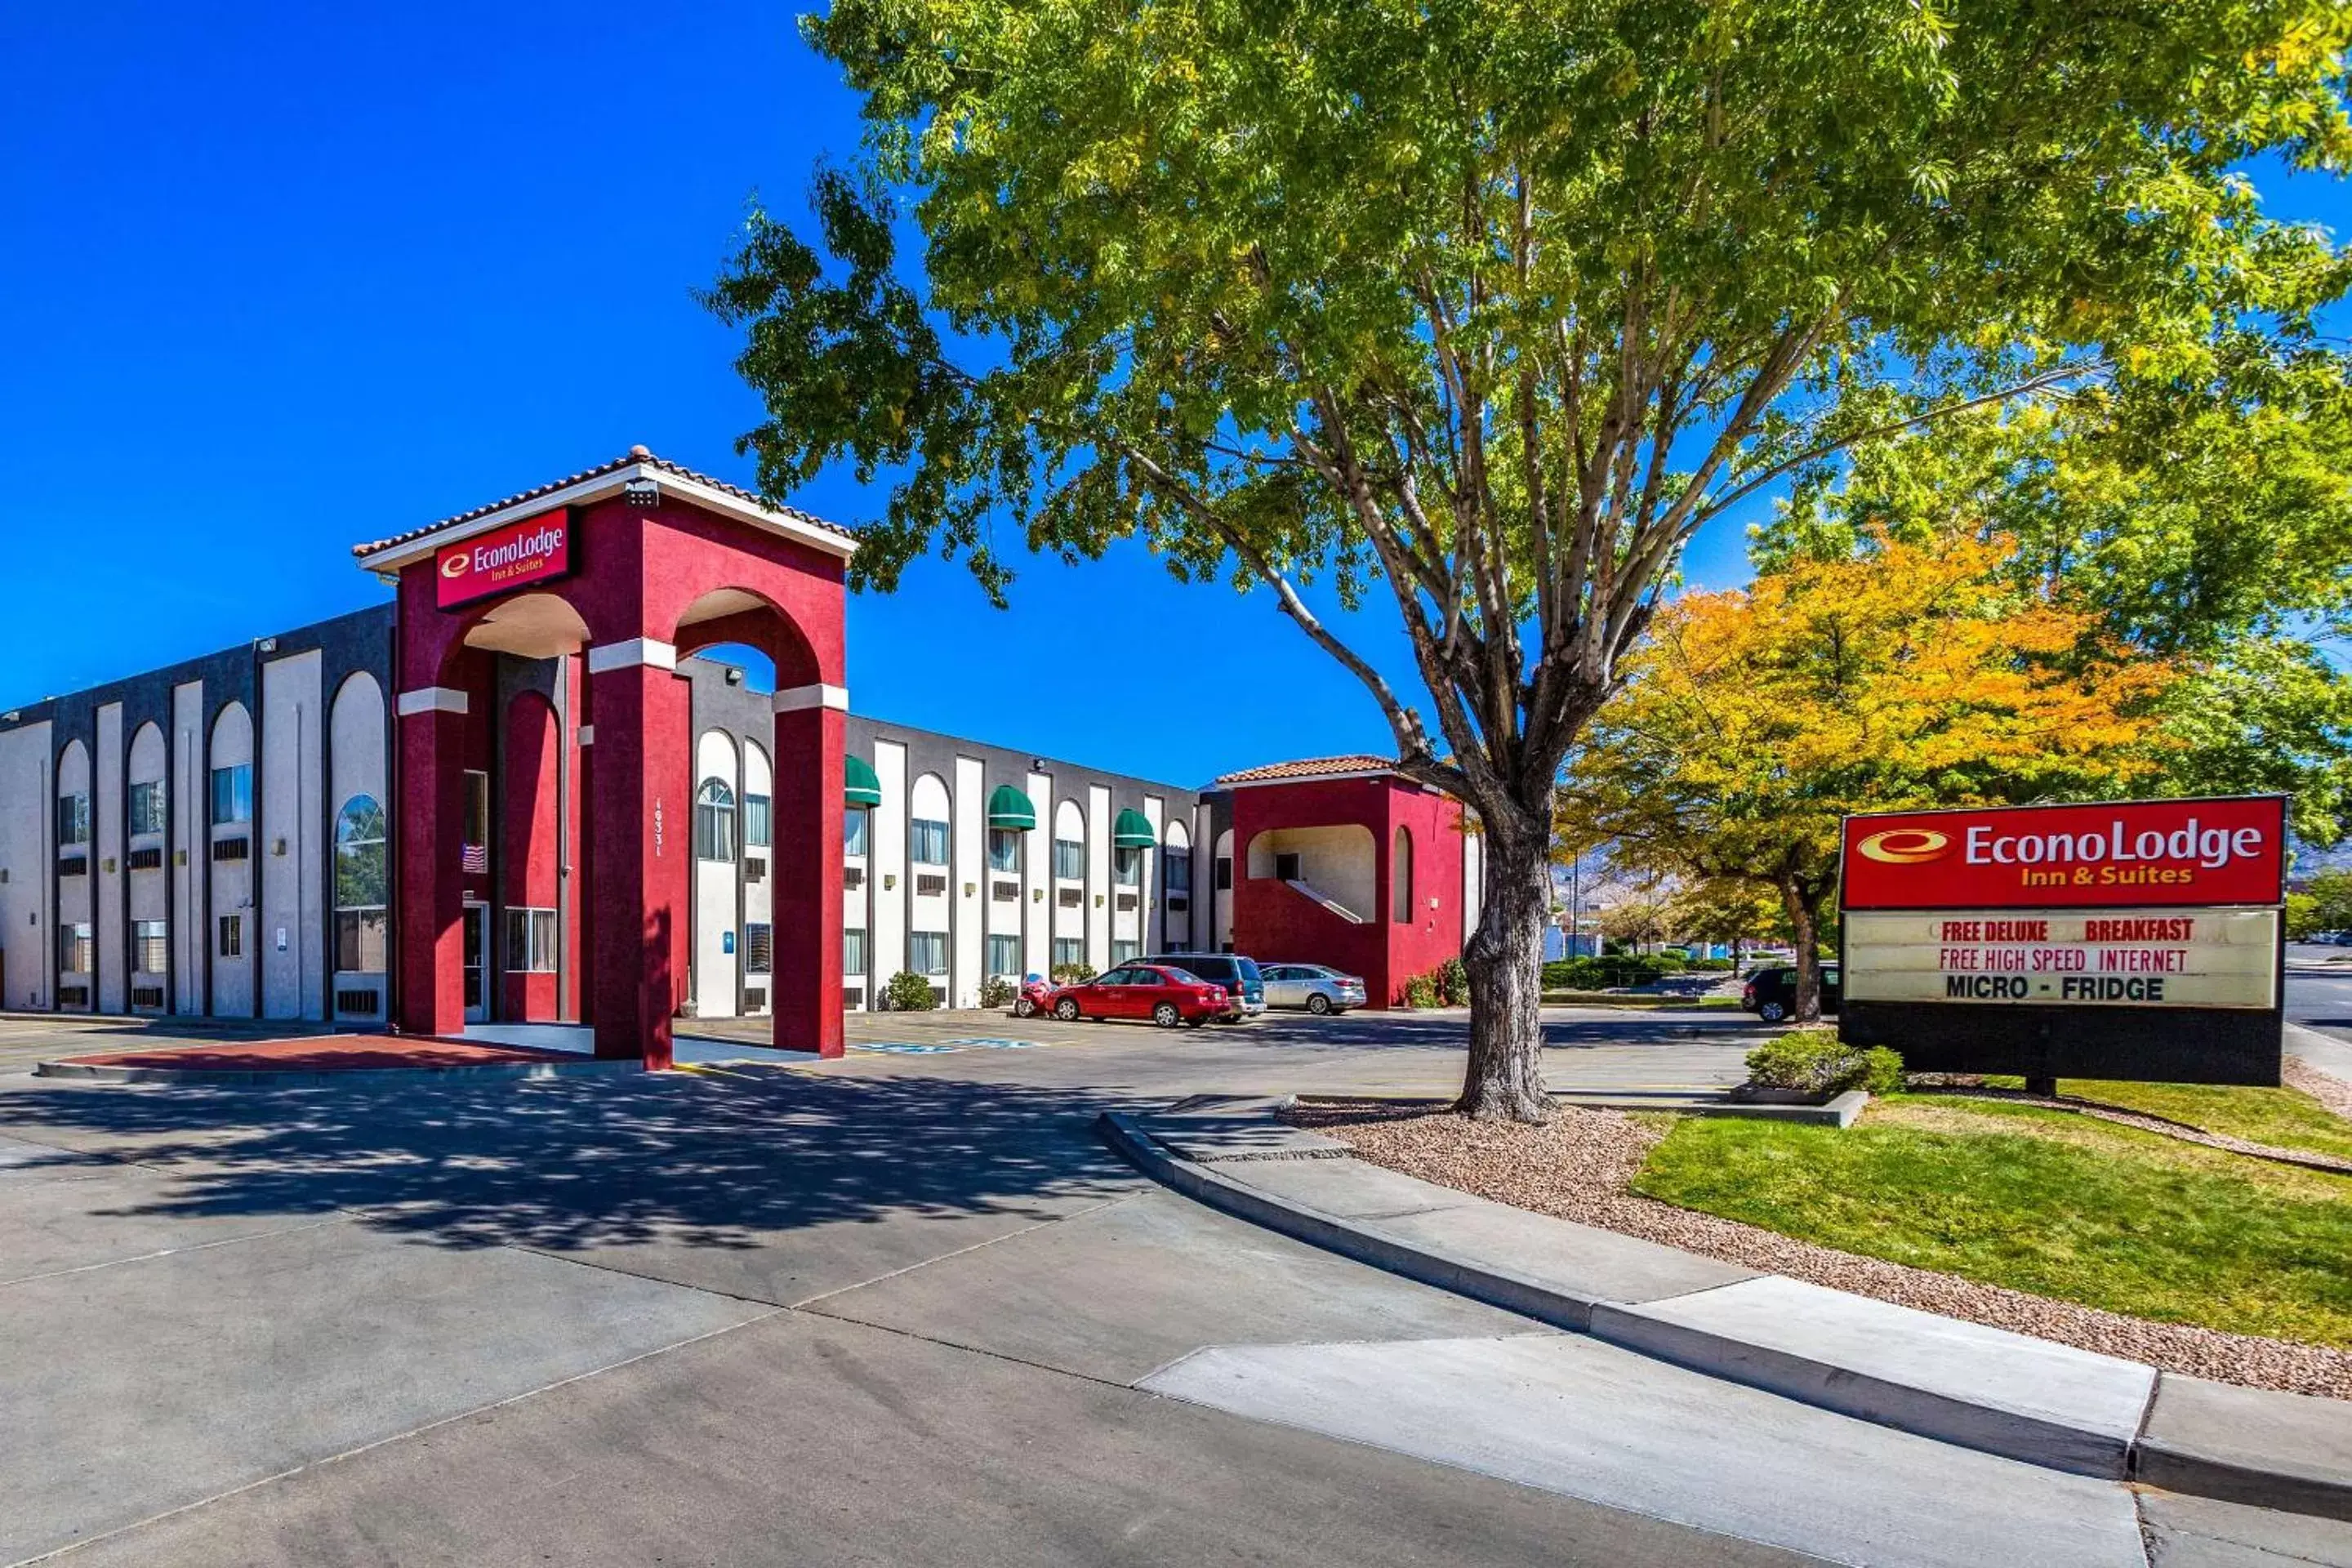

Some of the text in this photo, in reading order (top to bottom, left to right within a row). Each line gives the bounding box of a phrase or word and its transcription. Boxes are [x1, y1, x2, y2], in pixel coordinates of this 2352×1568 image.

[474, 526, 563, 572] EconoLodge
[506, 564, 514, 577] &
[515, 557, 544, 575] Suites
[1965, 818, 2263, 867] EconoLodge
[2021, 865, 2194, 886] Inn & Suites
[1941, 919, 2194, 942] FREE DELUXE BREAKFAST
[1940, 948, 2188, 972] FREE HIGH SPEED INTERNET
[1945, 975, 2029, 998] MICRO
[2060, 977, 2164, 1001] FRIDGE
